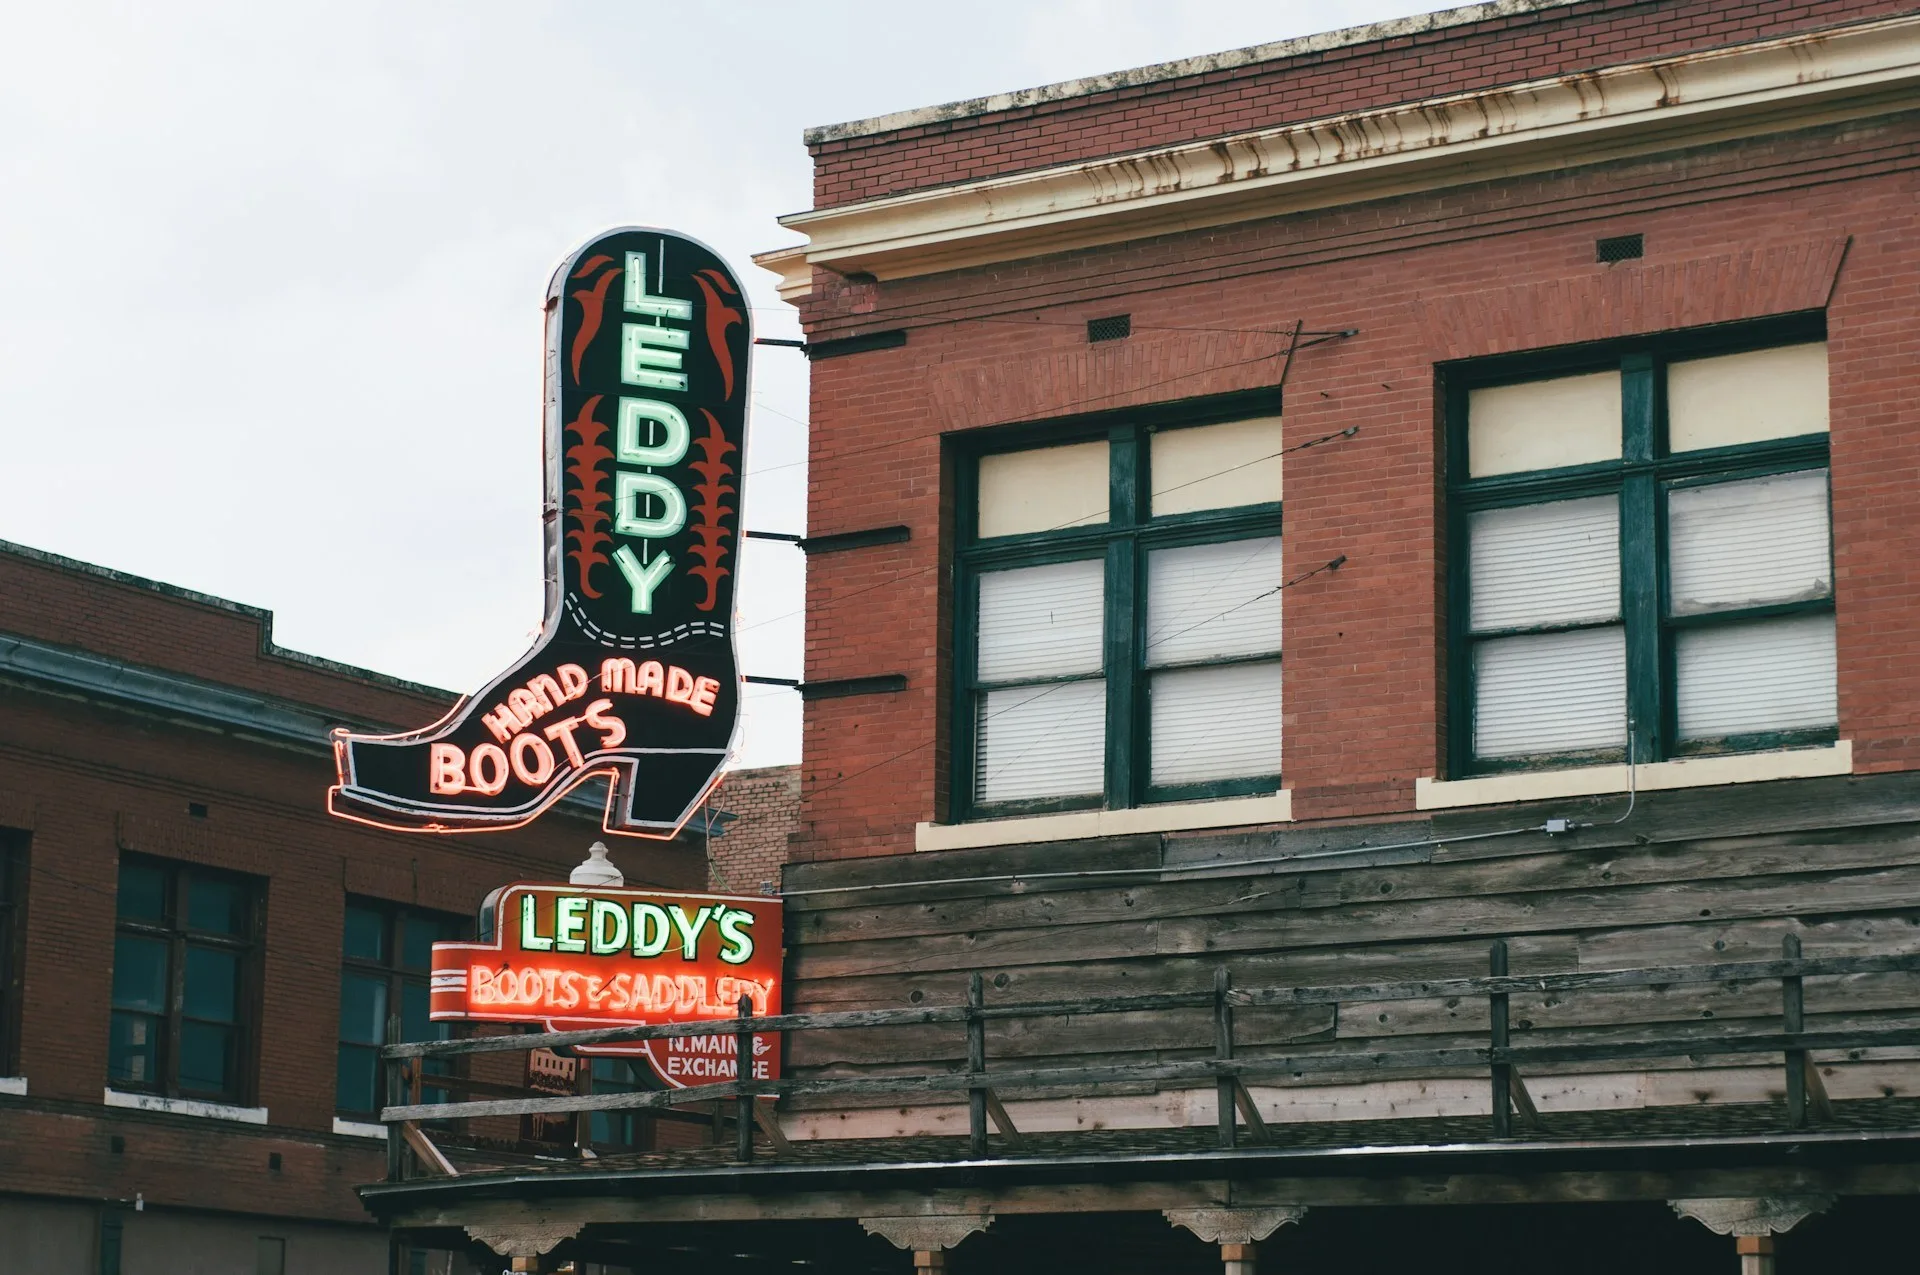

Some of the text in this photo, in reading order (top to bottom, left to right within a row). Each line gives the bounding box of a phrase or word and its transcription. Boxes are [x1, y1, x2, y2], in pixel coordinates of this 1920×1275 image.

[612, 250, 693, 615] LEDDY
[481, 656, 721, 743] HAND MADE
[429, 698, 627, 796] BOOTS
[520, 893, 755, 964] LEDDY'S
[470, 964, 580, 1010] BOOTS
[586, 974, 612, 1009] &
[751, 1035, 772, 1057] &
